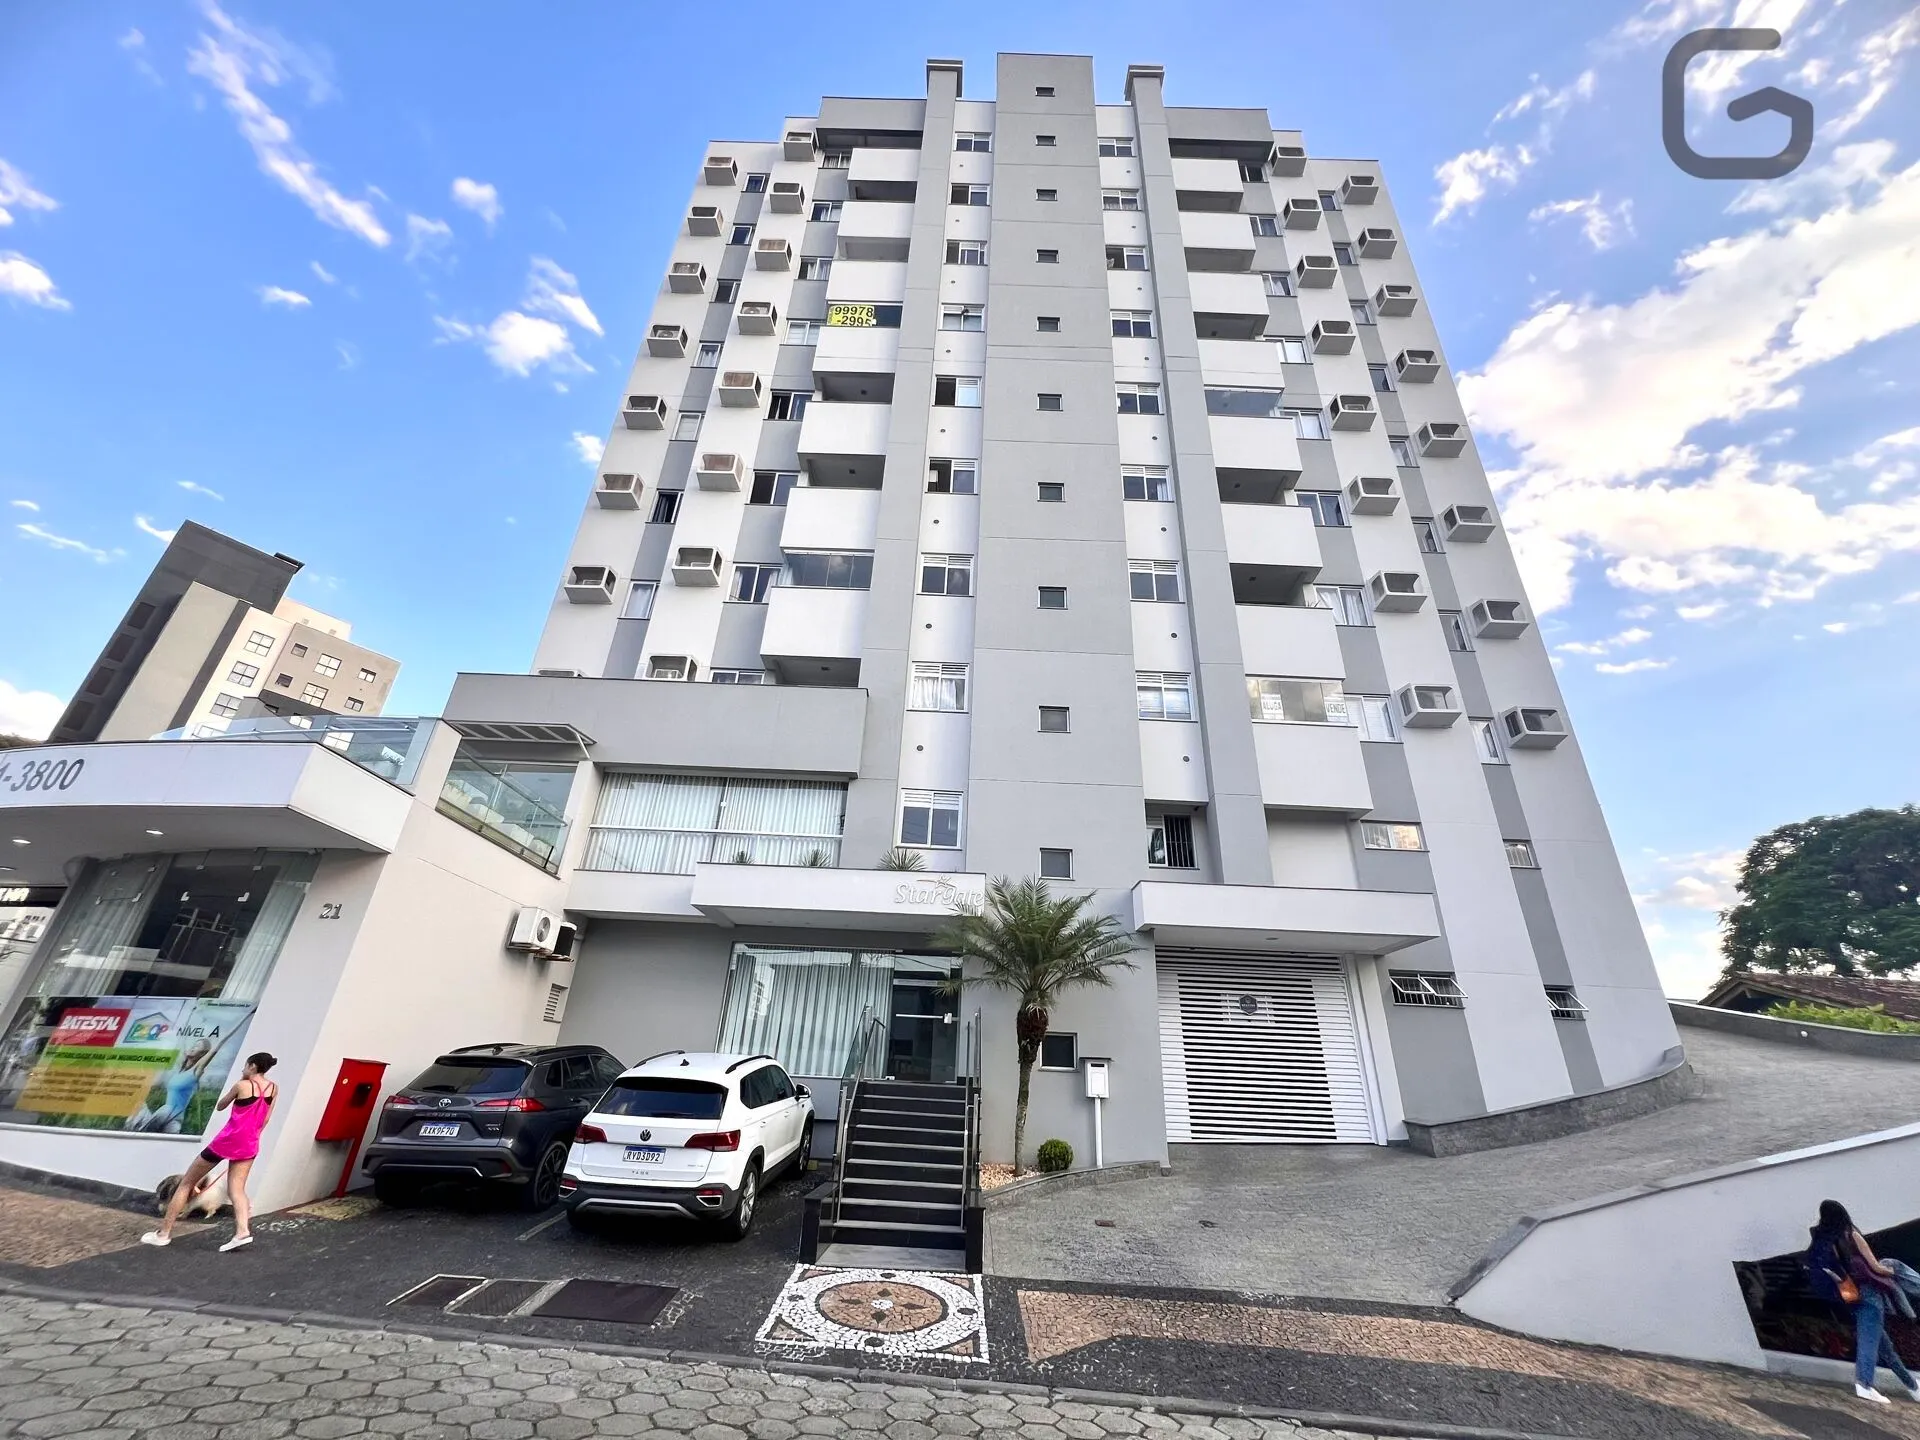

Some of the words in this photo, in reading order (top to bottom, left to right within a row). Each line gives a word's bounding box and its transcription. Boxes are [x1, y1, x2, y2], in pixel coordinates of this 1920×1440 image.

[834, 306, 874, 318] 99978
[1325, 703, 1346, 714] VENDE
[318, 903, 343, 920] 21
[176, 1025, 205, 1038] NÍVEL
[208, 1025, 220, 1038] A
[626, 1151, 661, 1162] RYD3D92
